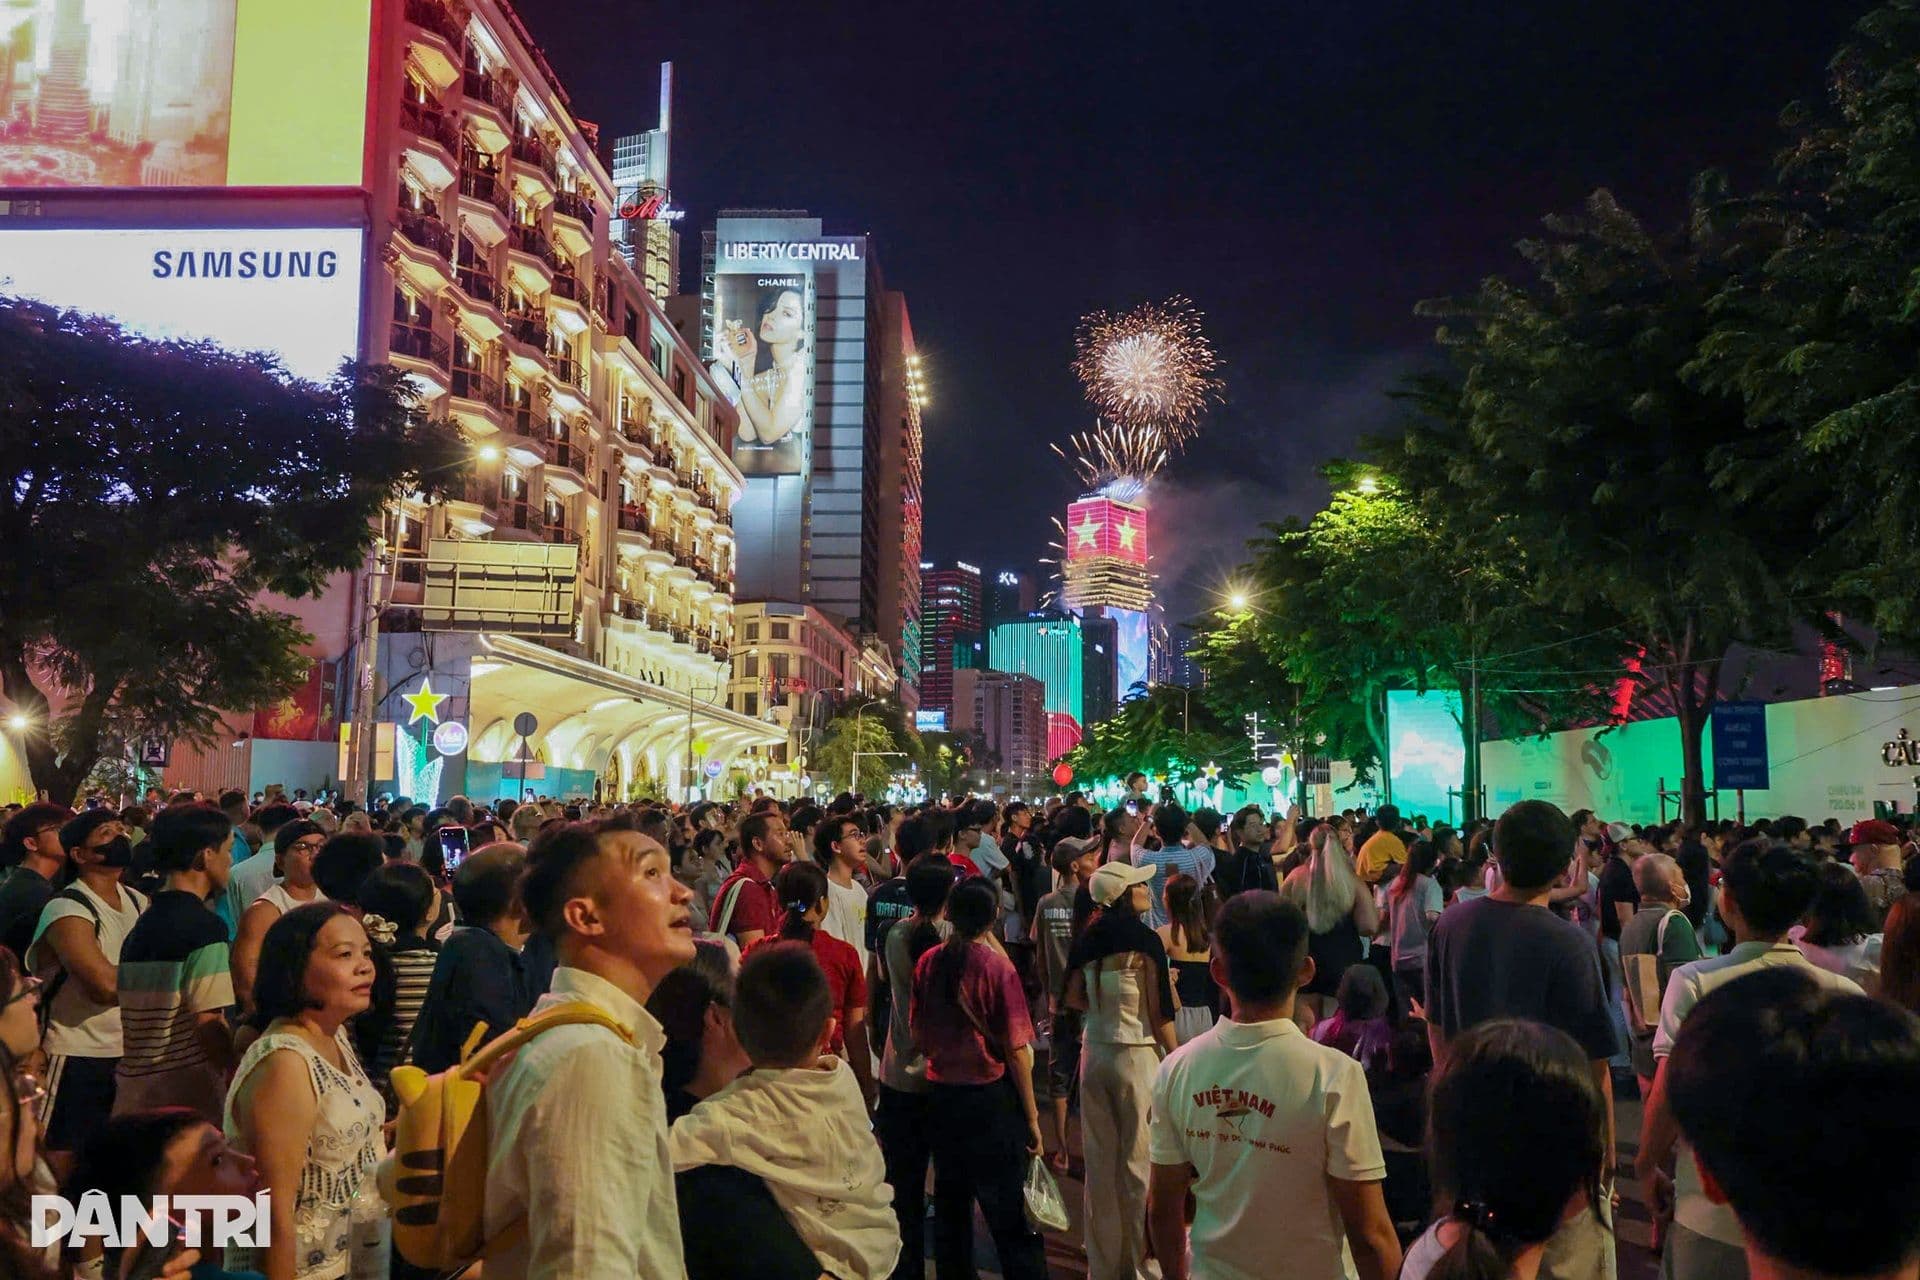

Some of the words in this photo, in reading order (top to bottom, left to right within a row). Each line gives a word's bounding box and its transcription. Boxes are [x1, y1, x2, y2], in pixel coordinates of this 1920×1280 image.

[724, 242, 787, 260] LIBERTY
[787, 242, 861, 260] CENTRAL
[153, 250, 338, 279] SAMSUNG
[757, 278, 800, 287] CHANEL
[1192, 1083, 1234, 1110] VIỆT
[1238, 1090, 1277, 1119] NAM
